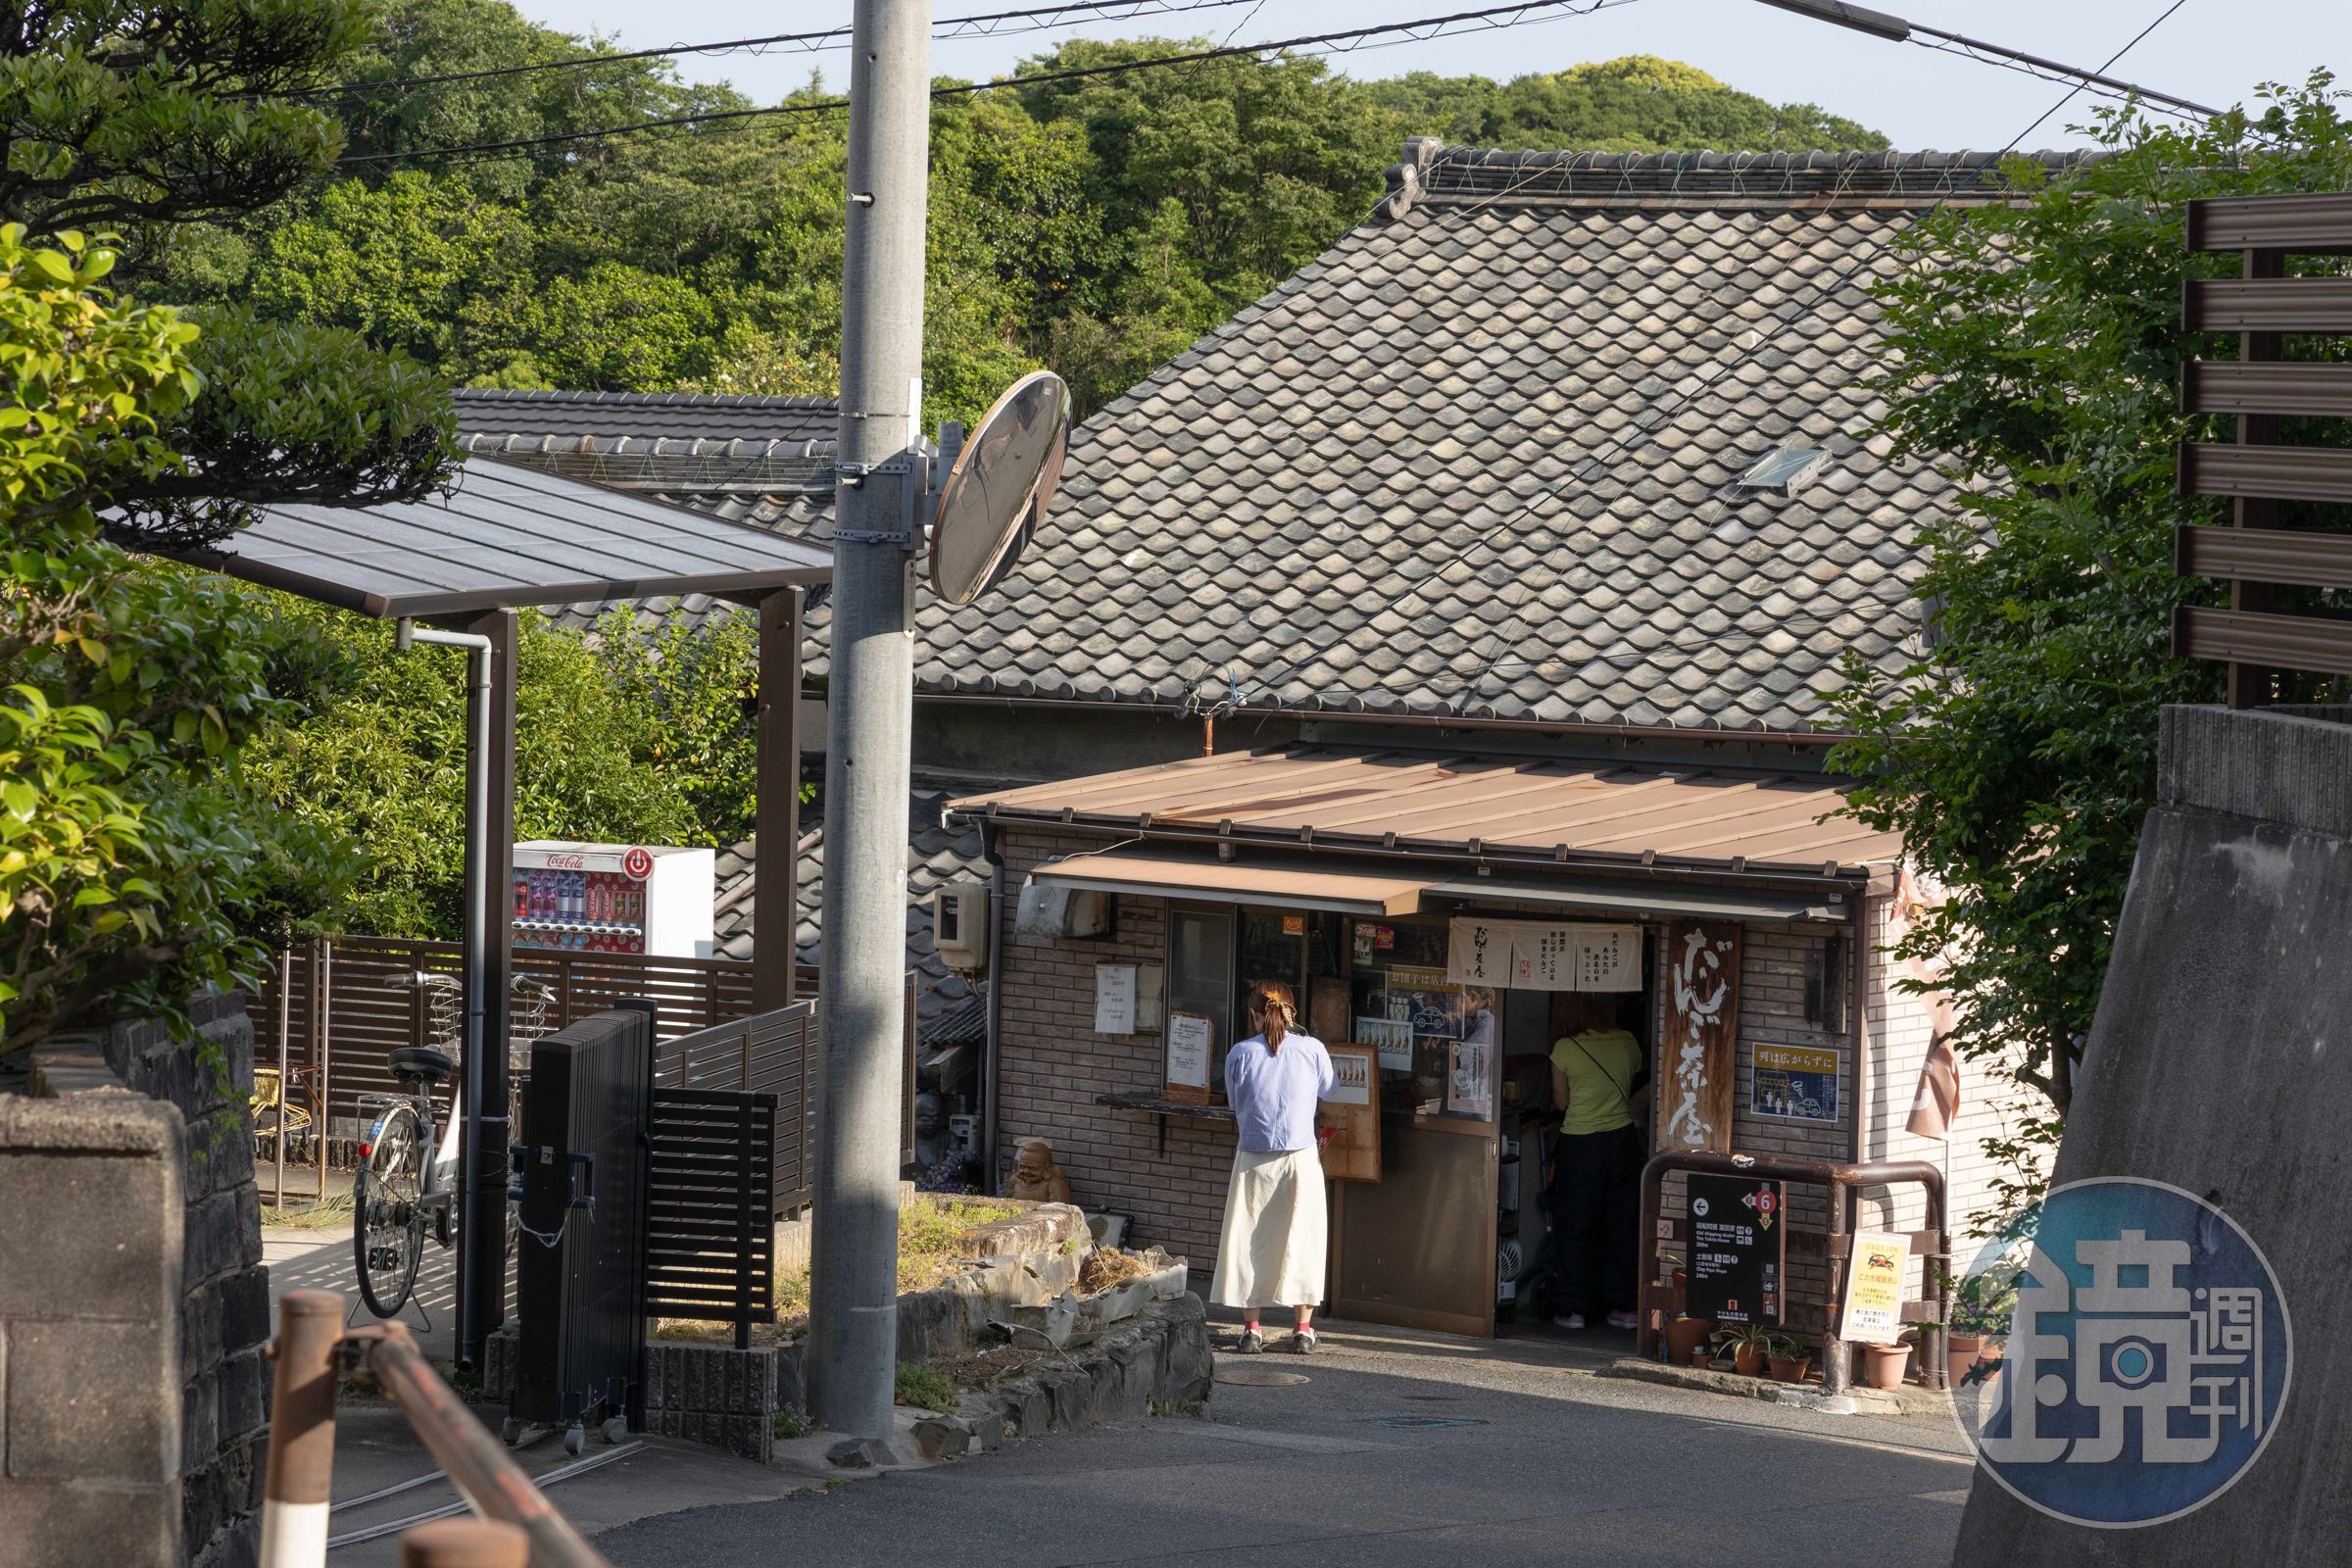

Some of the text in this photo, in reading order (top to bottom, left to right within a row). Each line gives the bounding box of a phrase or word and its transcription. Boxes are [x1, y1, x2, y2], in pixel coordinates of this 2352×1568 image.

[547, 854, 586, 869] Coca-Cola
[1669, 928, 1733, 1145] だんご茶屋
[1759, 1051, 1833, 1068] 列は広がらずに
[1761, 1195, 1770, 1210] 6
[1866, 1244, 1898, 1253] CAUTION
